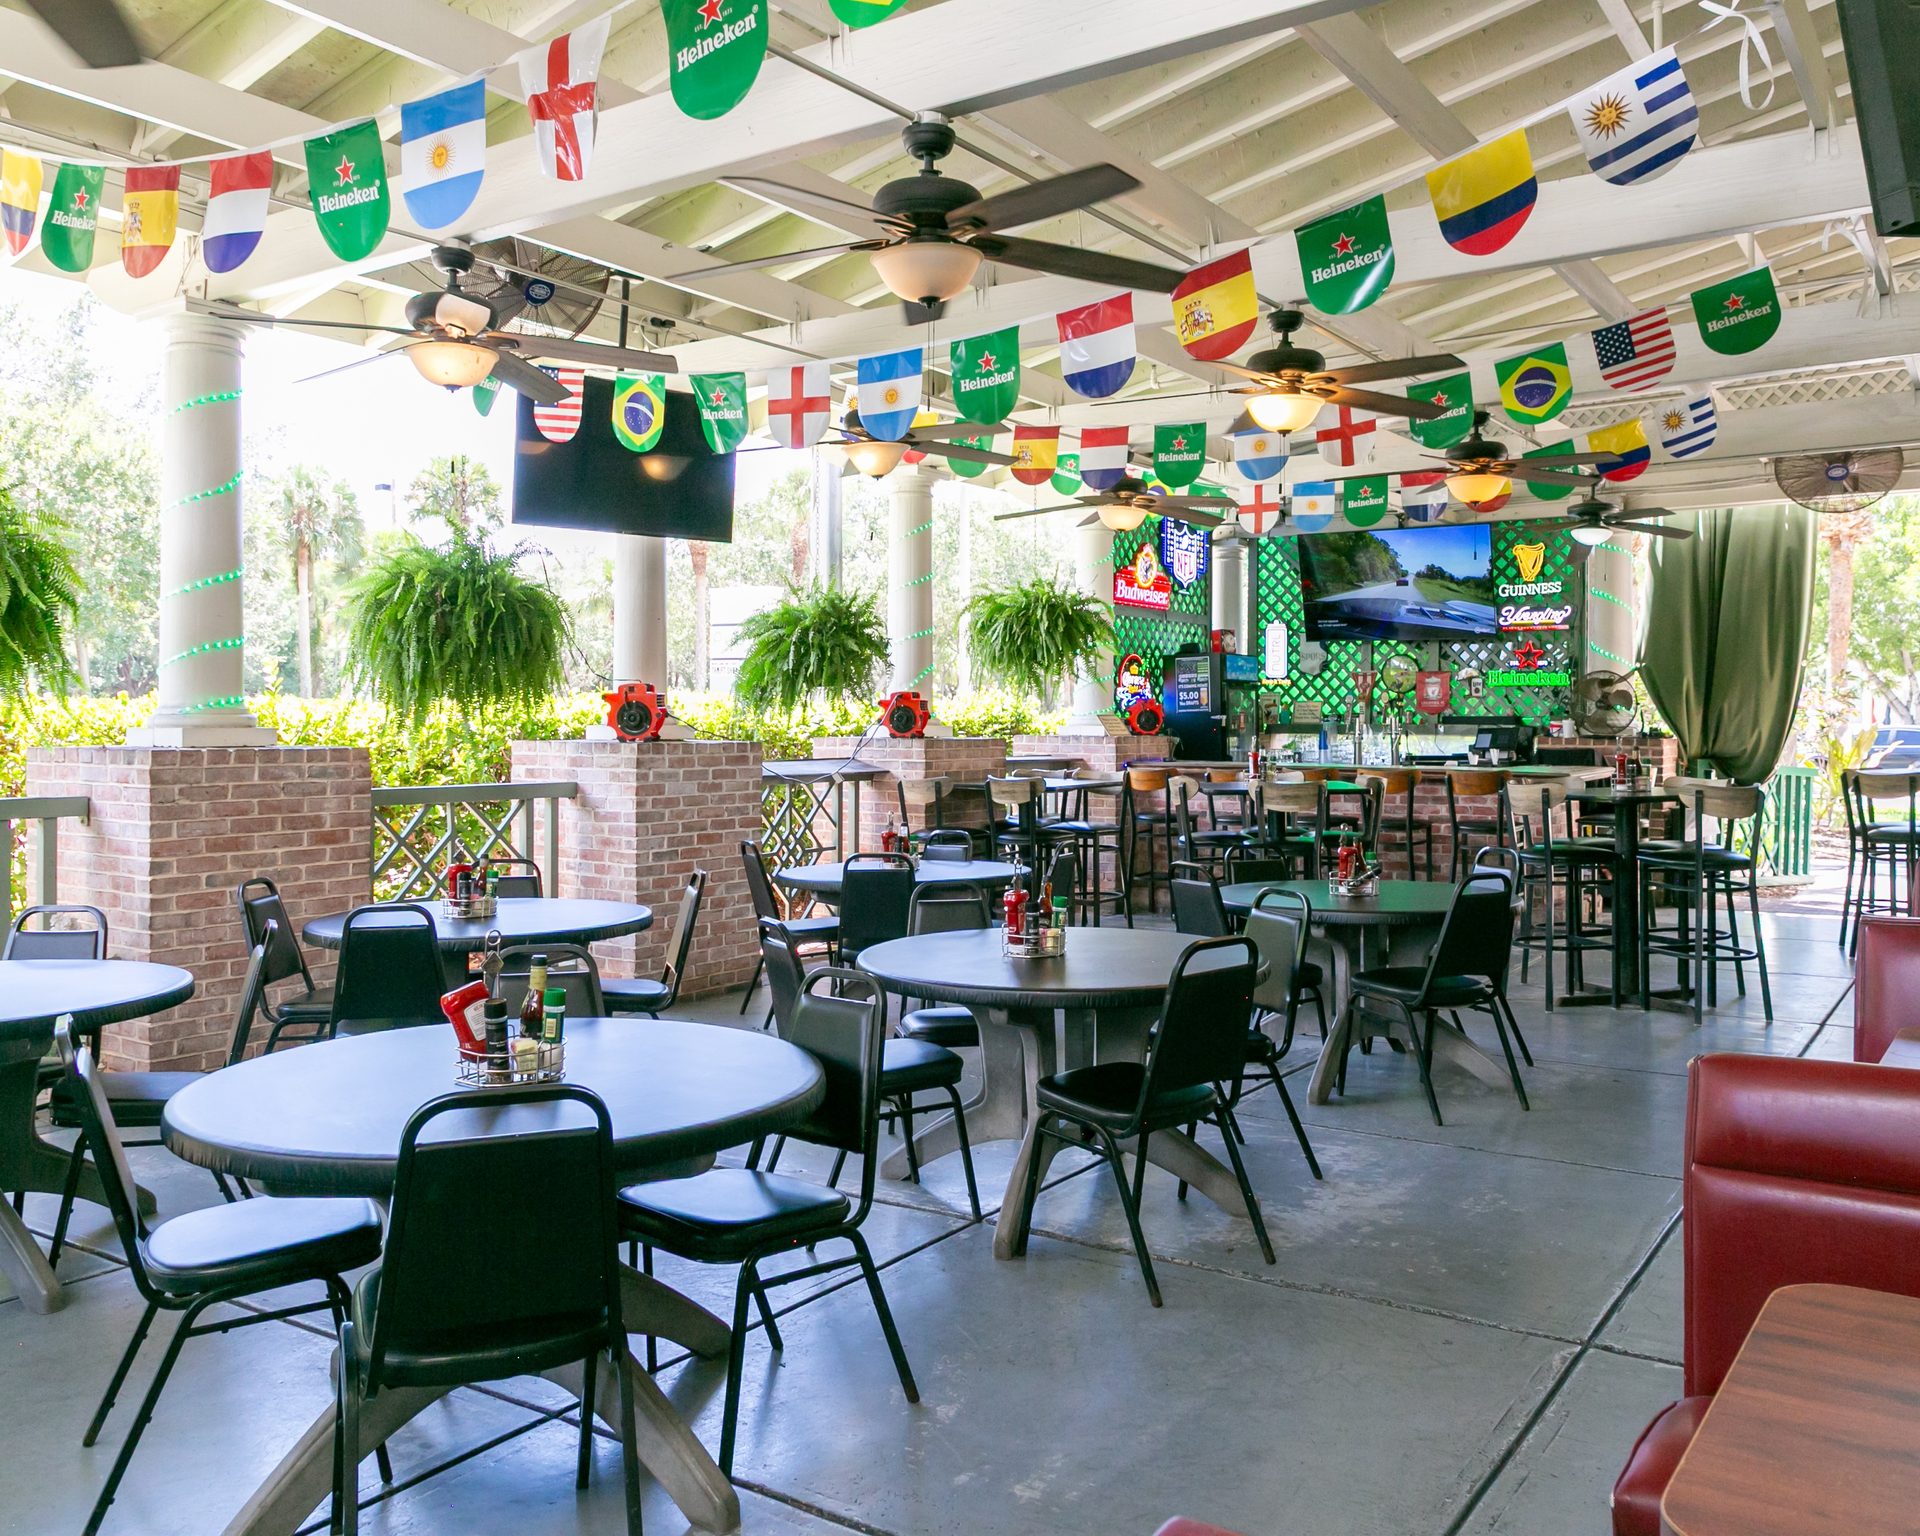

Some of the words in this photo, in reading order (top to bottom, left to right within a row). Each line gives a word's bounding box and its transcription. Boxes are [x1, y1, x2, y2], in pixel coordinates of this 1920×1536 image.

[677, 13, 757, 73] Heineken
[318, 185, 380, 214] Heineken
[51, 210, 96, 230] Heineke
[1311, 249, 1384, 284] Heineken
[1706, 305, 1772, 333] Heineken
[960, 370, 1014, 392] Heineken
[1158, 452, 1200, 463] Heineken
[1347, 497, 1385, 509] Heineken
[1177, 552, 1194, 577] NFL
[1115, 579, 1169, 605] Budweiser
[1499, 581, 1562, 598] GUINNESS
[1487, 669, 1570, 687] Heineken
[1179, 691, 1199, 701] $5.00
